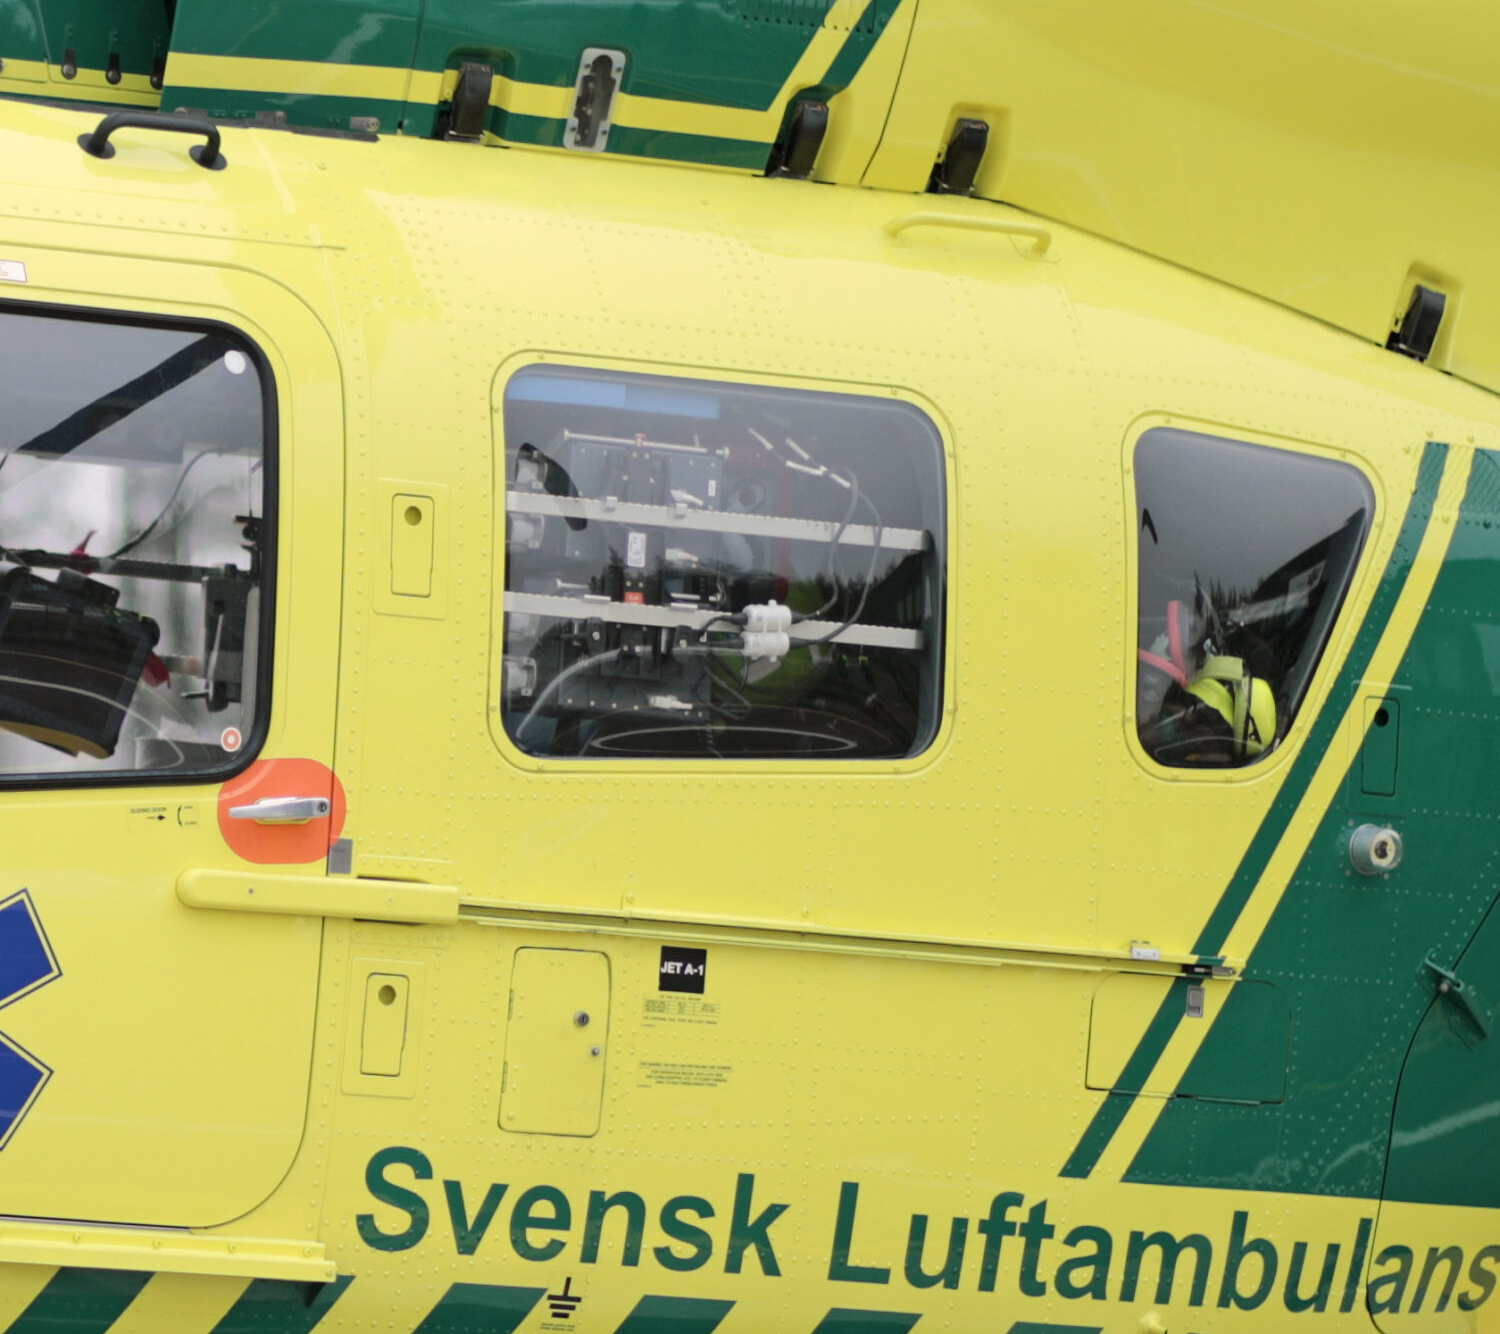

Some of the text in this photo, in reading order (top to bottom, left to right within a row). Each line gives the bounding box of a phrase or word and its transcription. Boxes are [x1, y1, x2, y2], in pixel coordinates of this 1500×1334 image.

[660, 961, 704, 976] JET A-1
[356, 1145, 792, 1278] Svensk
